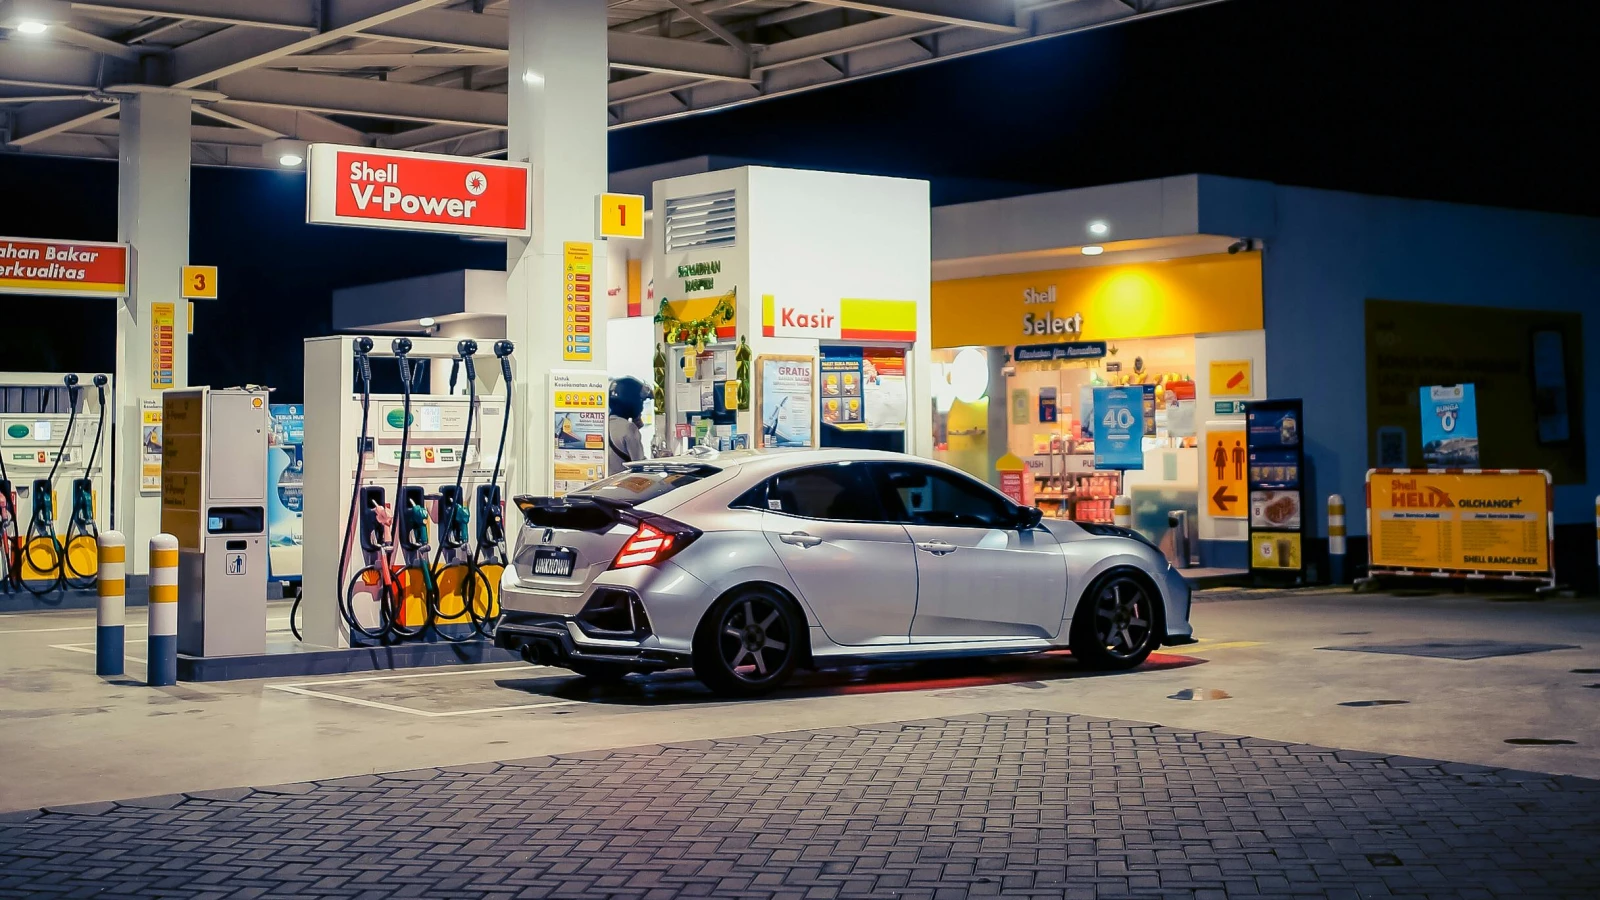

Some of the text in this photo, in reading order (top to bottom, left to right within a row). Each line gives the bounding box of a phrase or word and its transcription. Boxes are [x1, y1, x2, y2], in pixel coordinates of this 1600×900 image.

[350, 161, 398, 184] Shell
[350, 183, 477, 218] V-Power
[617, 204, 626, 226] 1
[45, 246, 98, 263] Bakar
[193, 273, 206, 291] 3
[1023, 285, 1057, 304] Shell
[782, 308, 835, 328] Kasir
[1023, 312, 1083, 335] Select
[778, 366, 810, 377] GRATIS
[579, 412, 605, 420] GRATIS
[1436, 404, 1459, 413] BUNGA
[1391, 480, 1416, 491] Shell
[1391, 486, 1455, 508] HELIX
[535, 558, 570, 575] UNKNOWN
[1464, 555, 1486, 563] SHELL
